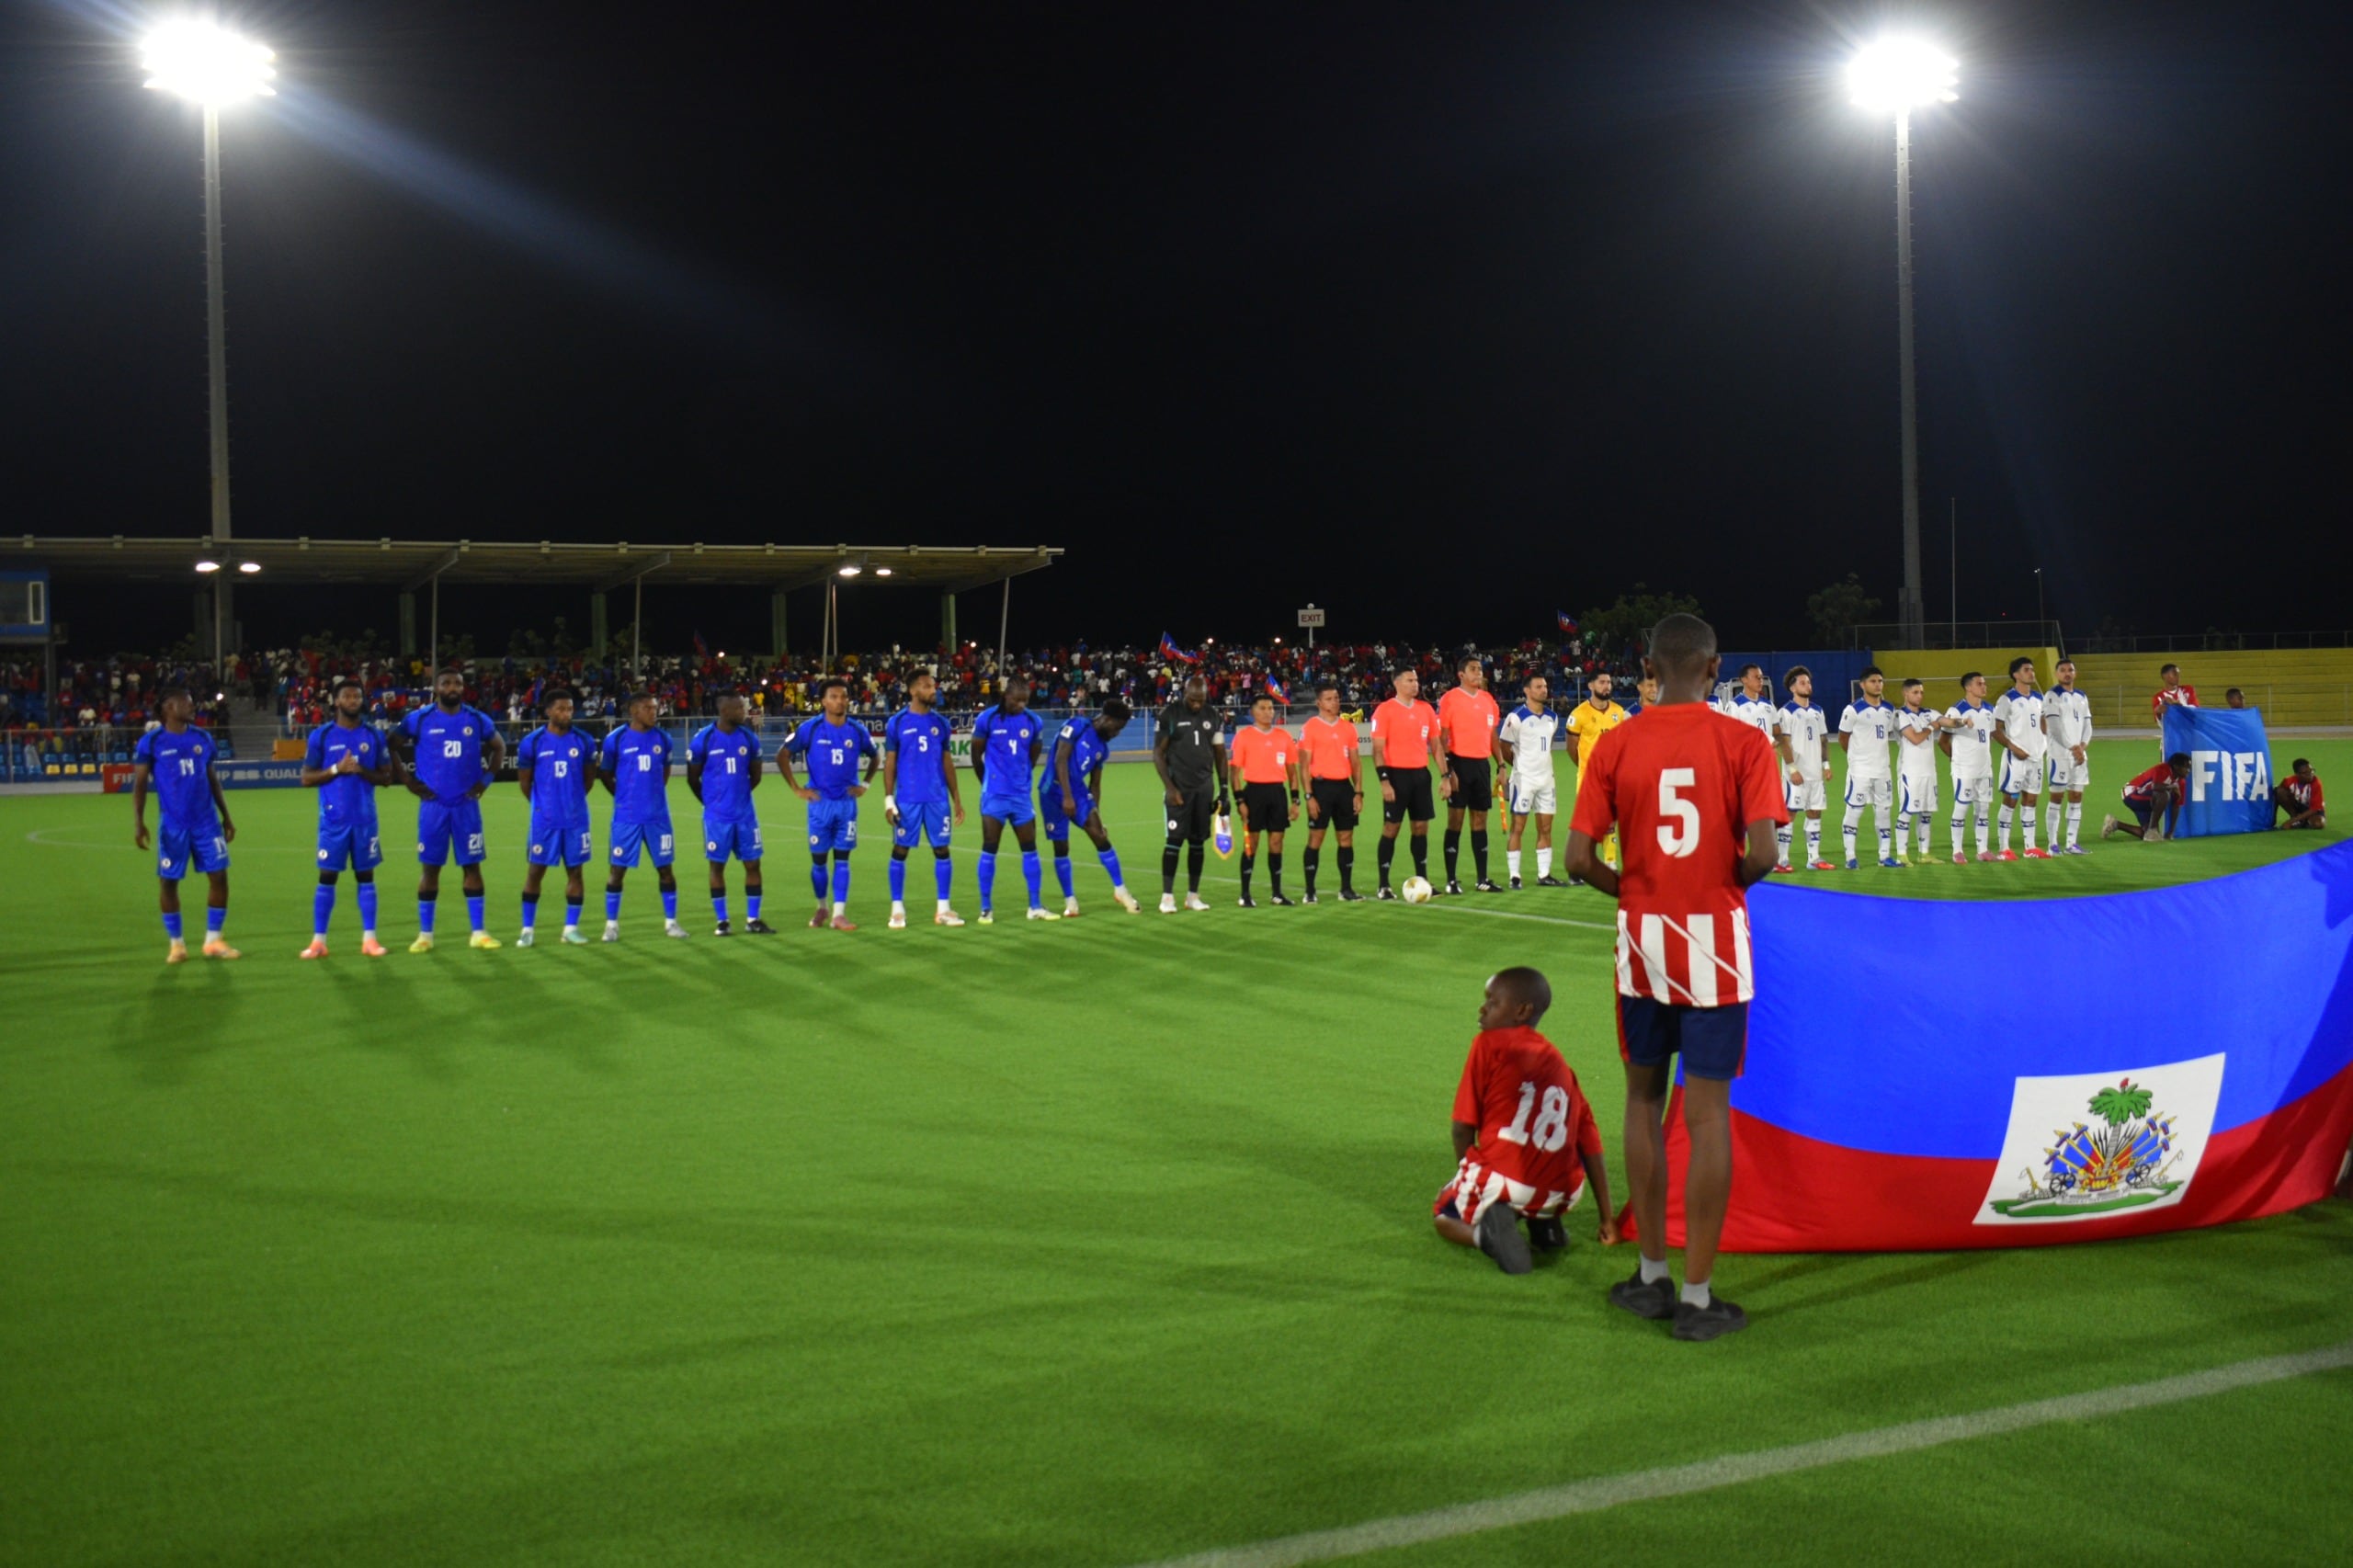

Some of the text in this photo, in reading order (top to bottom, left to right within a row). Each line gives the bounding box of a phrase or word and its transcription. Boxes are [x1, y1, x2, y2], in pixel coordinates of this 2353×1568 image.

[1301, 614, 1322, 623] EXIT
[2030, 713, 2037, 728] 5
[2074, 710, 2079, 722] 4
[1194, 730, 1199, 745] 1
[1807, 726, 1813, 741] 3
[1875, 724, 1884, 739] 16
[1977, 729, 1986, 743] 18
[443, 740, 462, 757] 20
[918, 735, 928, 753] 5
[1008, 739, 1017, 756] 4
[1540, 736, 1547, 751] 11
[638, 755, 651, 771] 10
[831, 748, 844, 765] 15
[1081, 756, 1090, 771] 2
[179, 758, 195, 776] 14
[264, 767, 304, 779] QUAL
[554, 760, 567, 778] 13
[726, 757, 736, 774] 11
[113, 773, 136, 784] FIF
[2190, 750, 2269, 801] FIFA
[1657, 767, 1699, 858] 5
[943, 816, 950, 832] 5
[468, 834, 483, 849] 20
[661, 835, 672, 850] 10
[1497, 1082, 1569, 1153] 18
